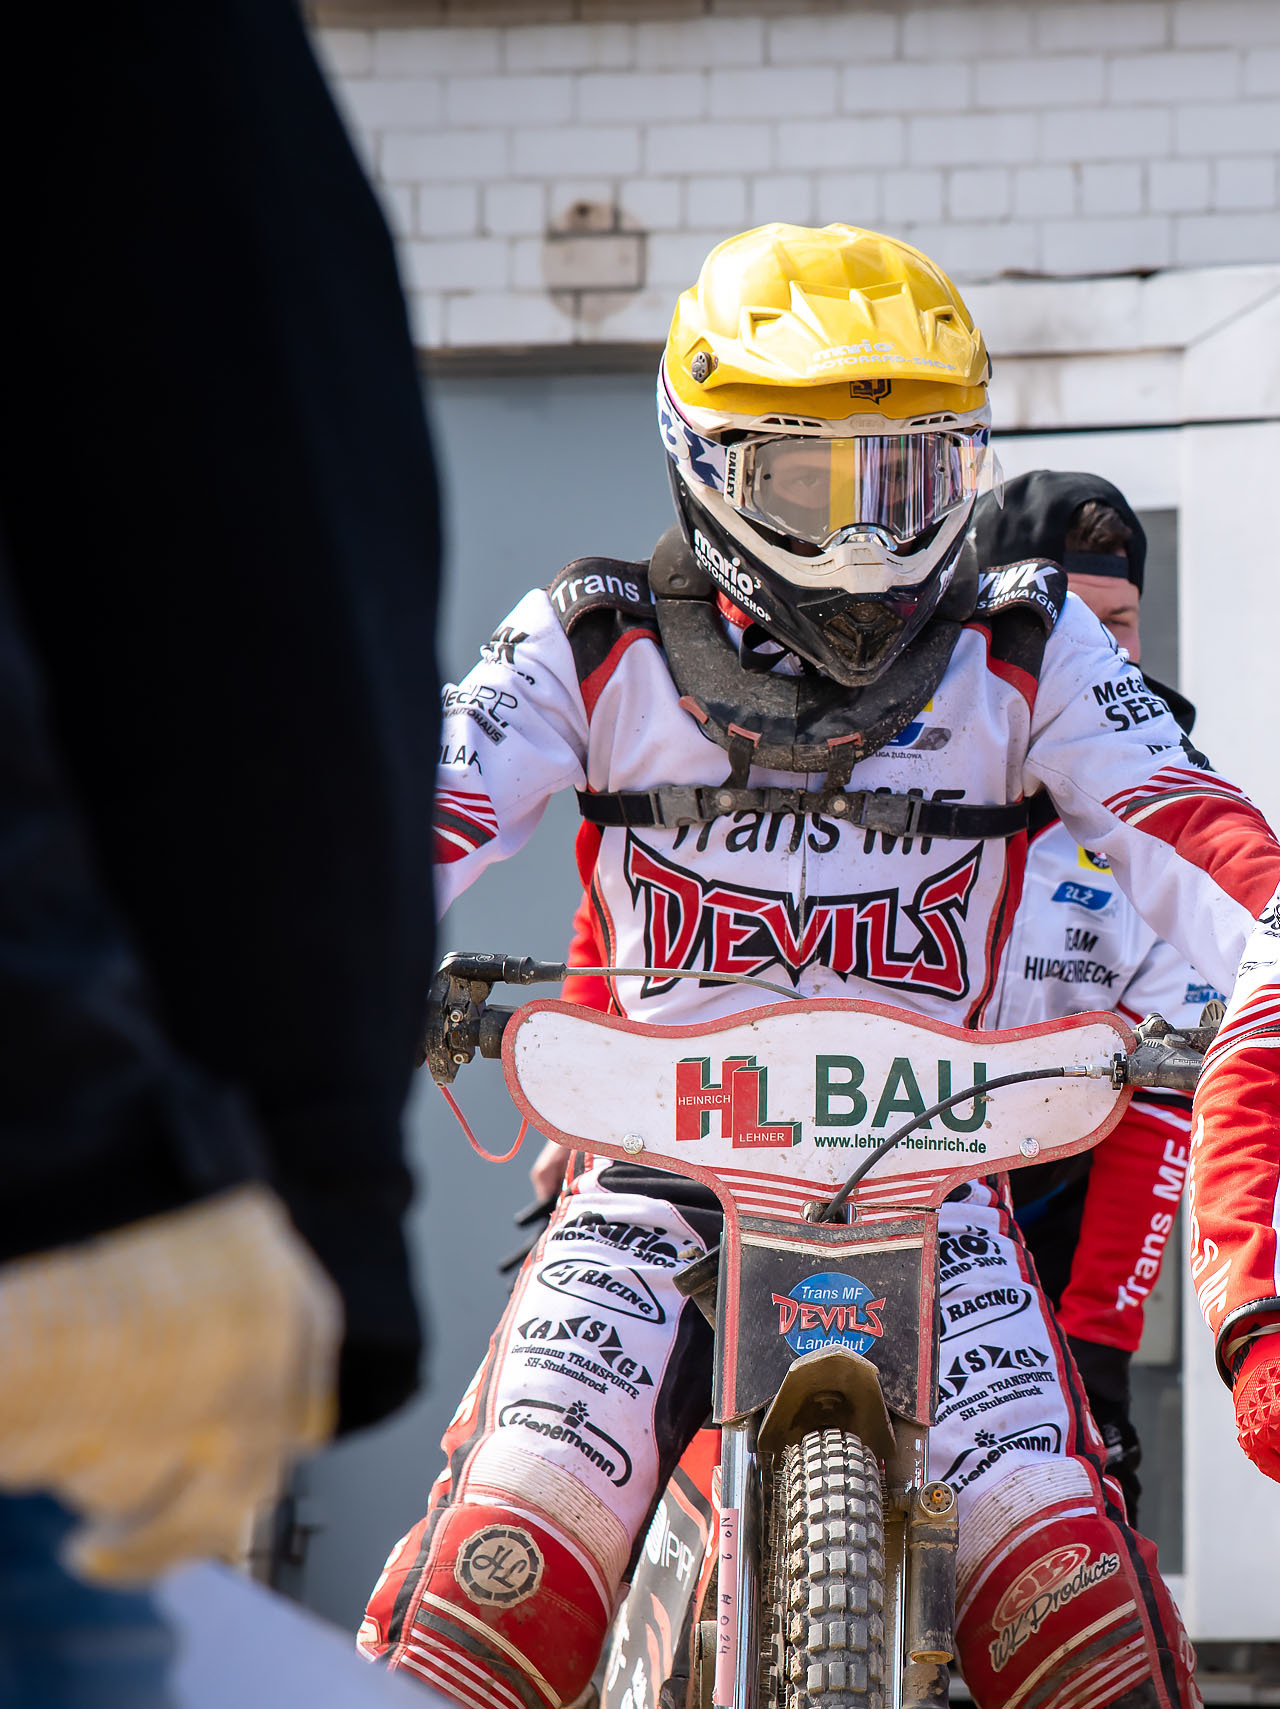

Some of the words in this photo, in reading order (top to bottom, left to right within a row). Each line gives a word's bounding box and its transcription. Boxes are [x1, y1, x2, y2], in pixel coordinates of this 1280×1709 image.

[727, 451, 737, 499] OAKLEY
[552, 574, 640, 613] Trans
[624, 828, 984, 1001] DEVILS
[1064, 927, 1099, 953] TEAM
[678, 1094, 731, 1106] HEINRICH
[814, 1055, 987, 1133] BAU
[738, 1132, 785, 1143] LEHNER
[814, 1133, 987, 1154] www.lehnr-heinrich.de
[1115, 1212, 1173, 1312] Trans
[1152, 1138, 1189, 1202] MF
[577, 1268, 654, 1315] RACING
[802, 1286, 838, 1299] Trans
[842, 1287, 863, 1300] MF
[950, 1288, 1019, 1322] RACING
[772, 1292, 887, 1338] DEVILS
[524, 1356, 610, 1396] SH-Stukenbrock
[567, 1352, 640, 1400] TRANSPORTE
[987, 1371, 1056, 1394] TRANSPORTE
[960, 1385, 1043, 1422] SH-Stukenbrock
[508, 1412, 617, 1479] Lienemann
[951, 1433, 1052, 1495] Lienemann
[1025, 1555, 1118, 1631] Products
